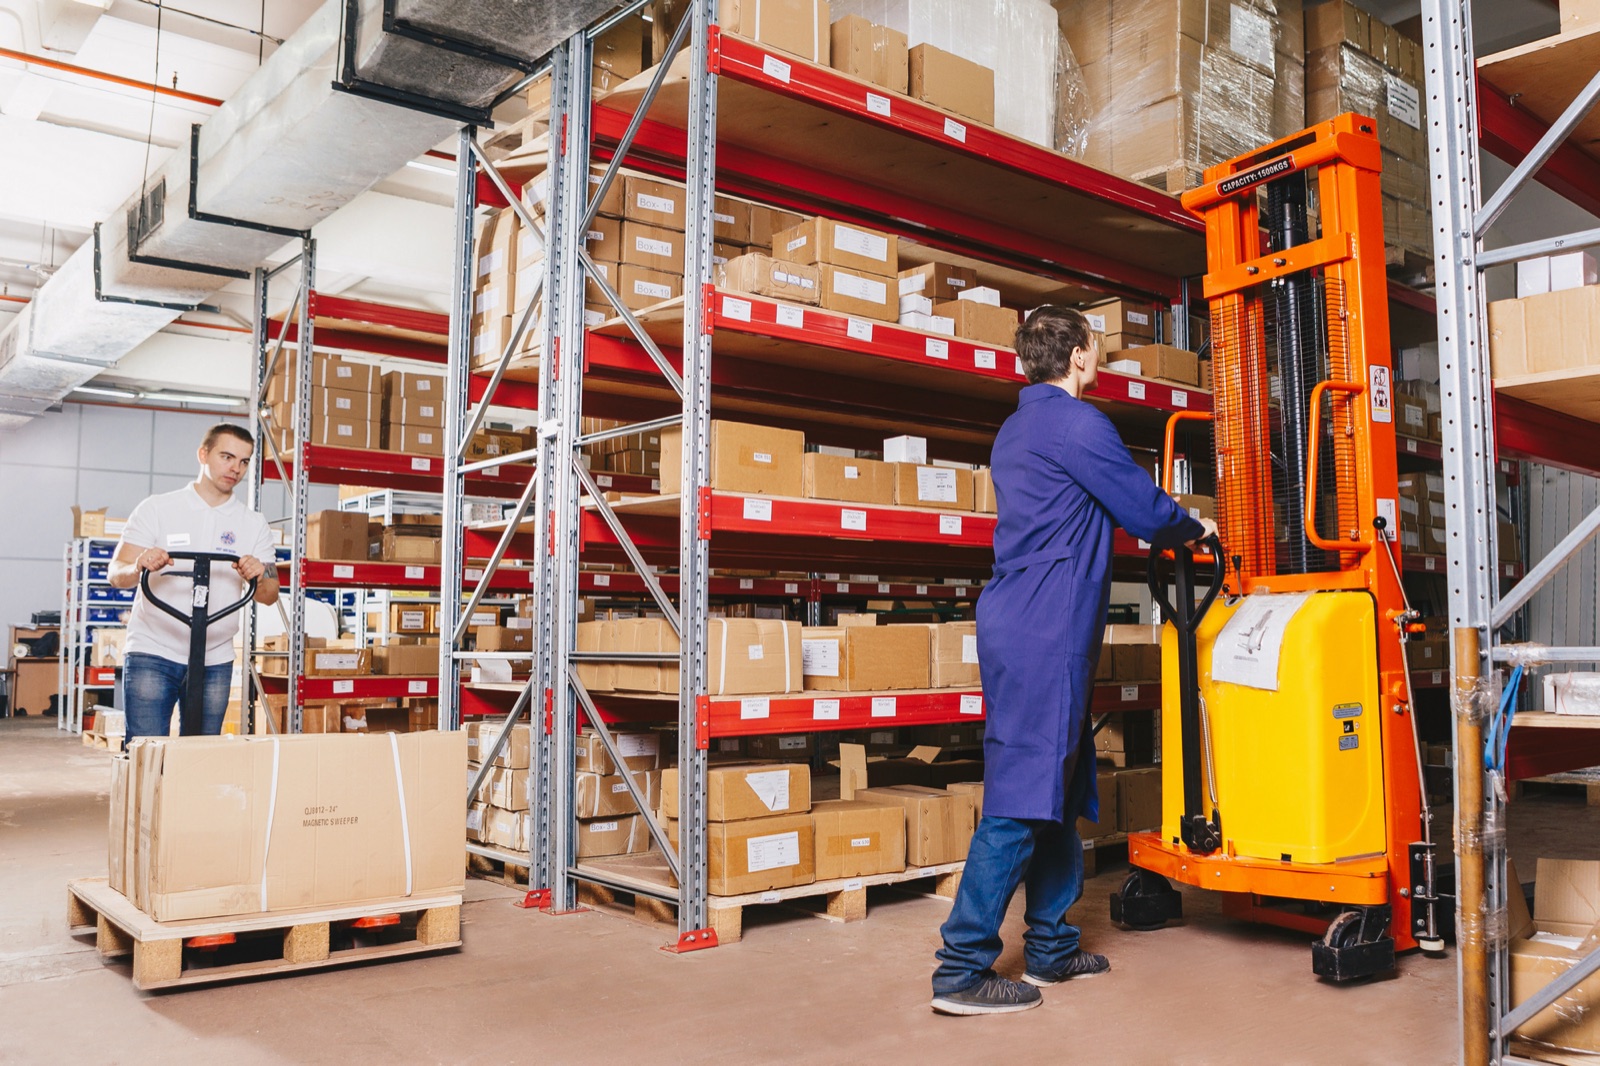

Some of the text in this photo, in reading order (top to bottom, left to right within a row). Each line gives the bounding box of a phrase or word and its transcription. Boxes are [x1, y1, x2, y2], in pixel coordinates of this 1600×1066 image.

[1222, 160, 1289, 192] CAPACITY: 1500KGS
[640, 198, 672, 211] Box- 13
[637, 240, 669, 254] Box- 14
[637, 284, 669, 297] Box- 19
[302, 816, 359, 827] MAGNETIC SWEEPER
[606, 822, 614, 830] 31
